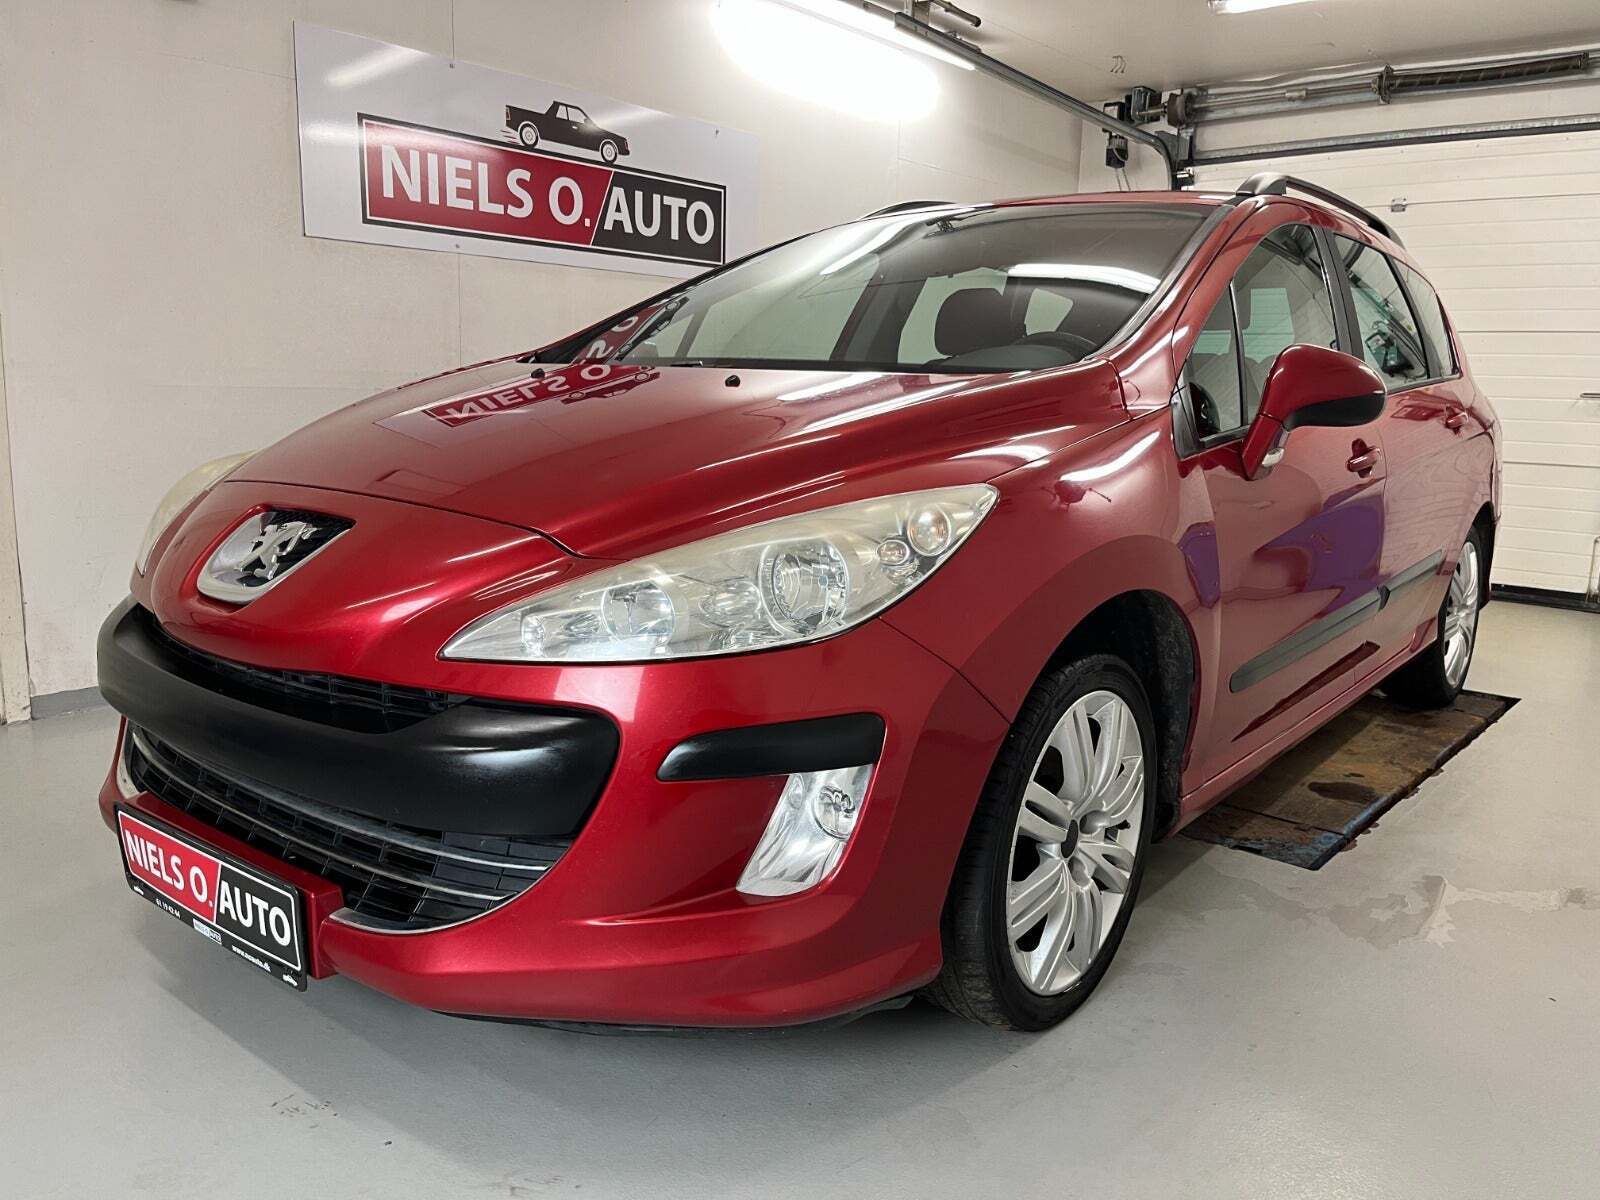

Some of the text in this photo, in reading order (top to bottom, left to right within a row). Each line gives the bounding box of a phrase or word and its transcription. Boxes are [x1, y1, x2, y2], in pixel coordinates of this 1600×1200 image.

[381, 144, 715, 245] NIELS O. AUTO
[125, 829, 185, 891] NIELS
[189, 865, 214, 908] O.
[219, 880, 291, 947] AUTO
